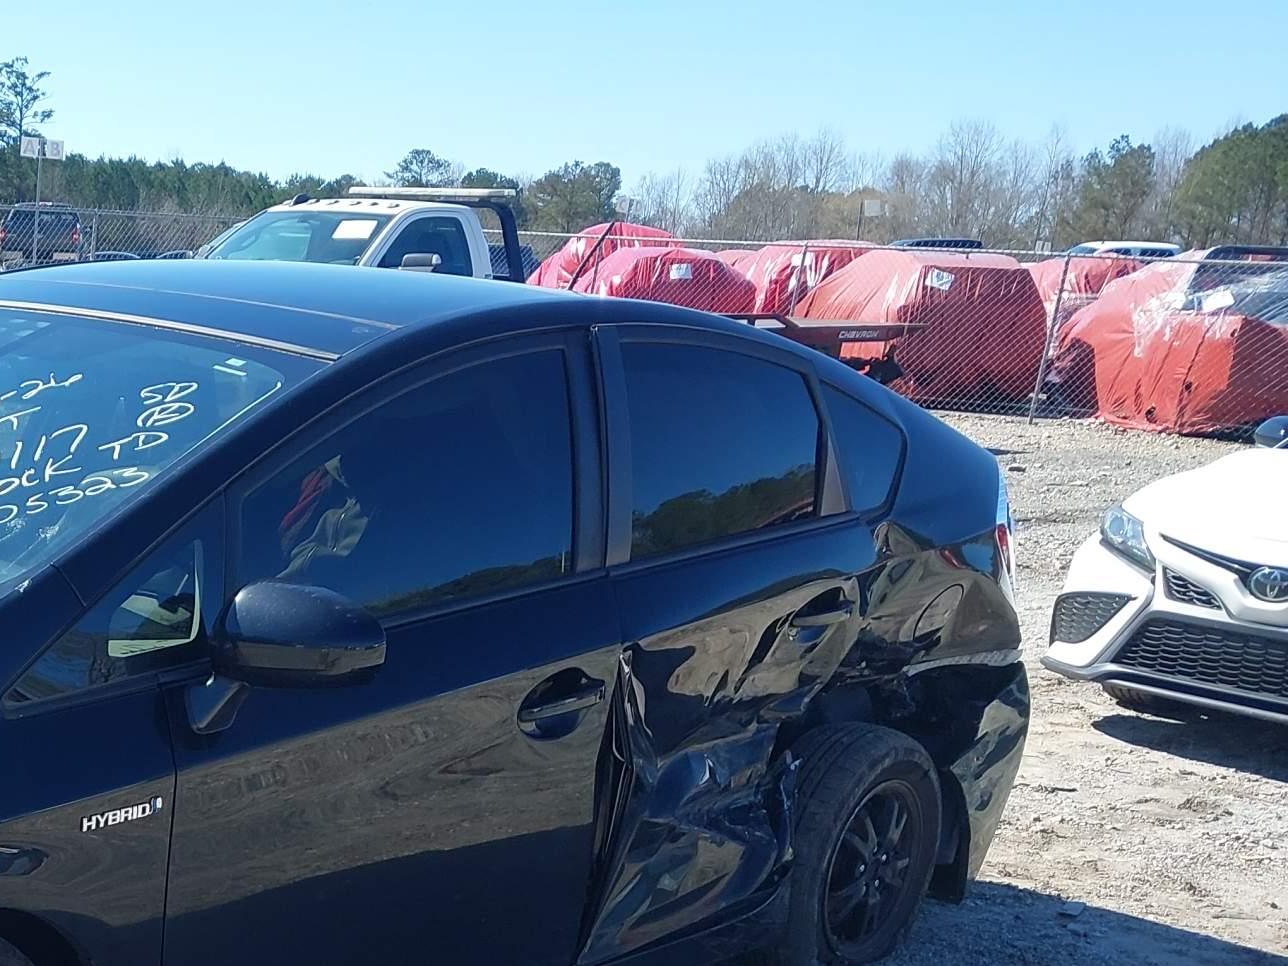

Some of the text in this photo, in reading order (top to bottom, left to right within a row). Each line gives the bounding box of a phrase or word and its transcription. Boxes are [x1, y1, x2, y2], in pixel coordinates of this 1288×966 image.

[839, 330, 880, 339] CHEVRON
[98, 431, 169, 460] TD
[82, 803, 150, 832] HYBRID
